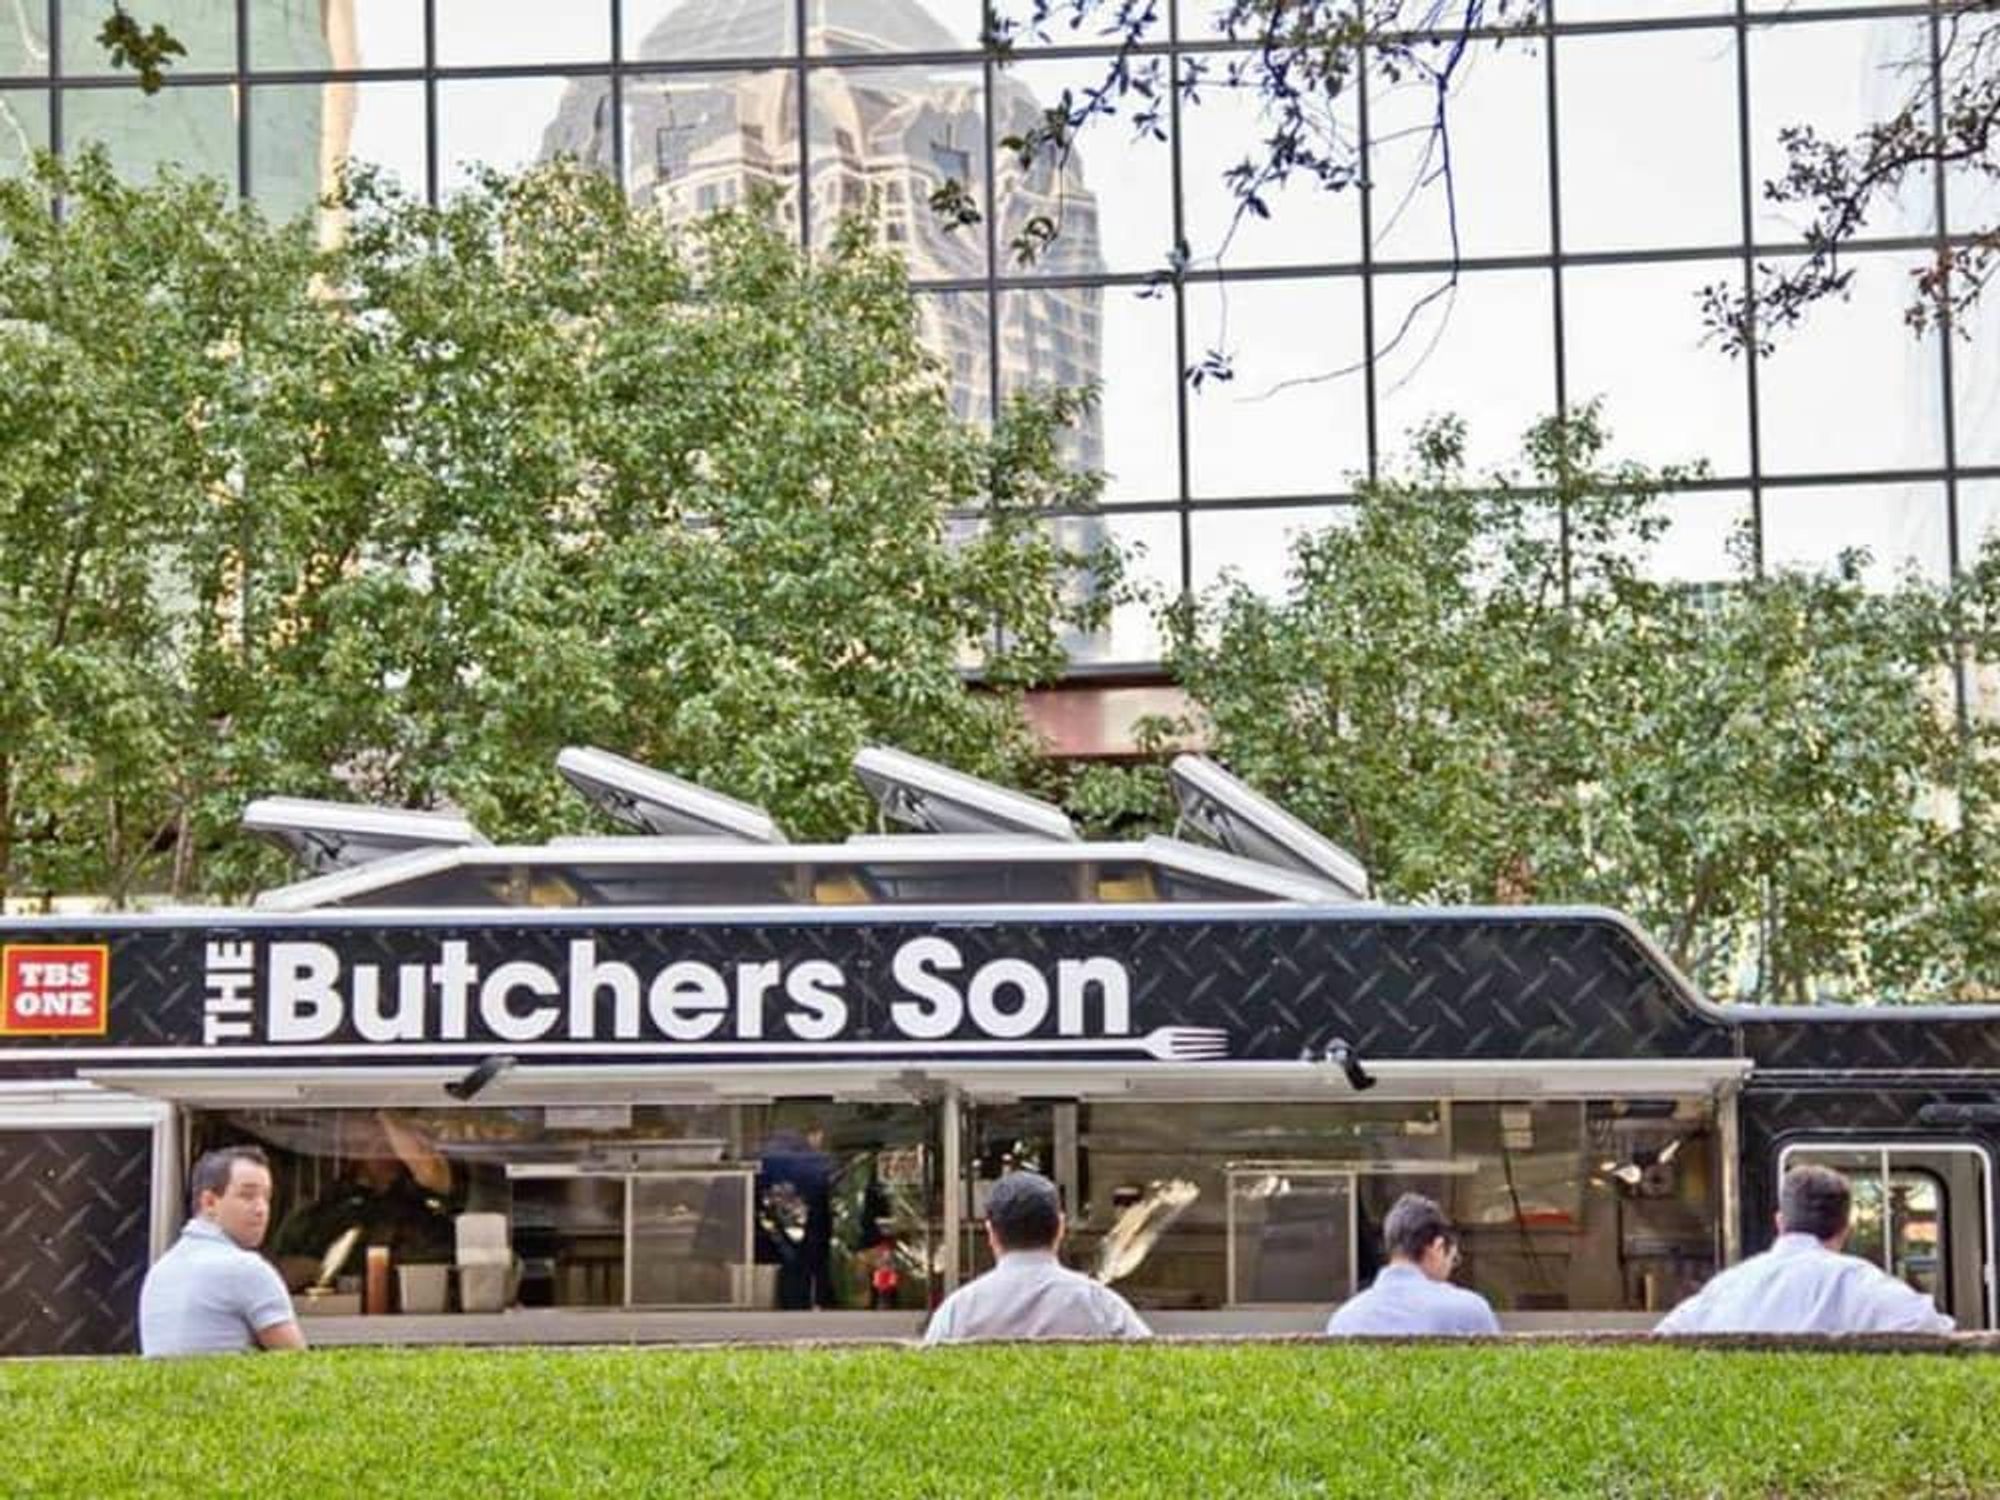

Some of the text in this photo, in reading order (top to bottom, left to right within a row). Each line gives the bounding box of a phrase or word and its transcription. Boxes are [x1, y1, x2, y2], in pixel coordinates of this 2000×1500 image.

[18, 962, 91, 988] TBS
[14, 991, 94, 1017] ONE
[204, 937, 1130, 1046] THE Butchers Son
